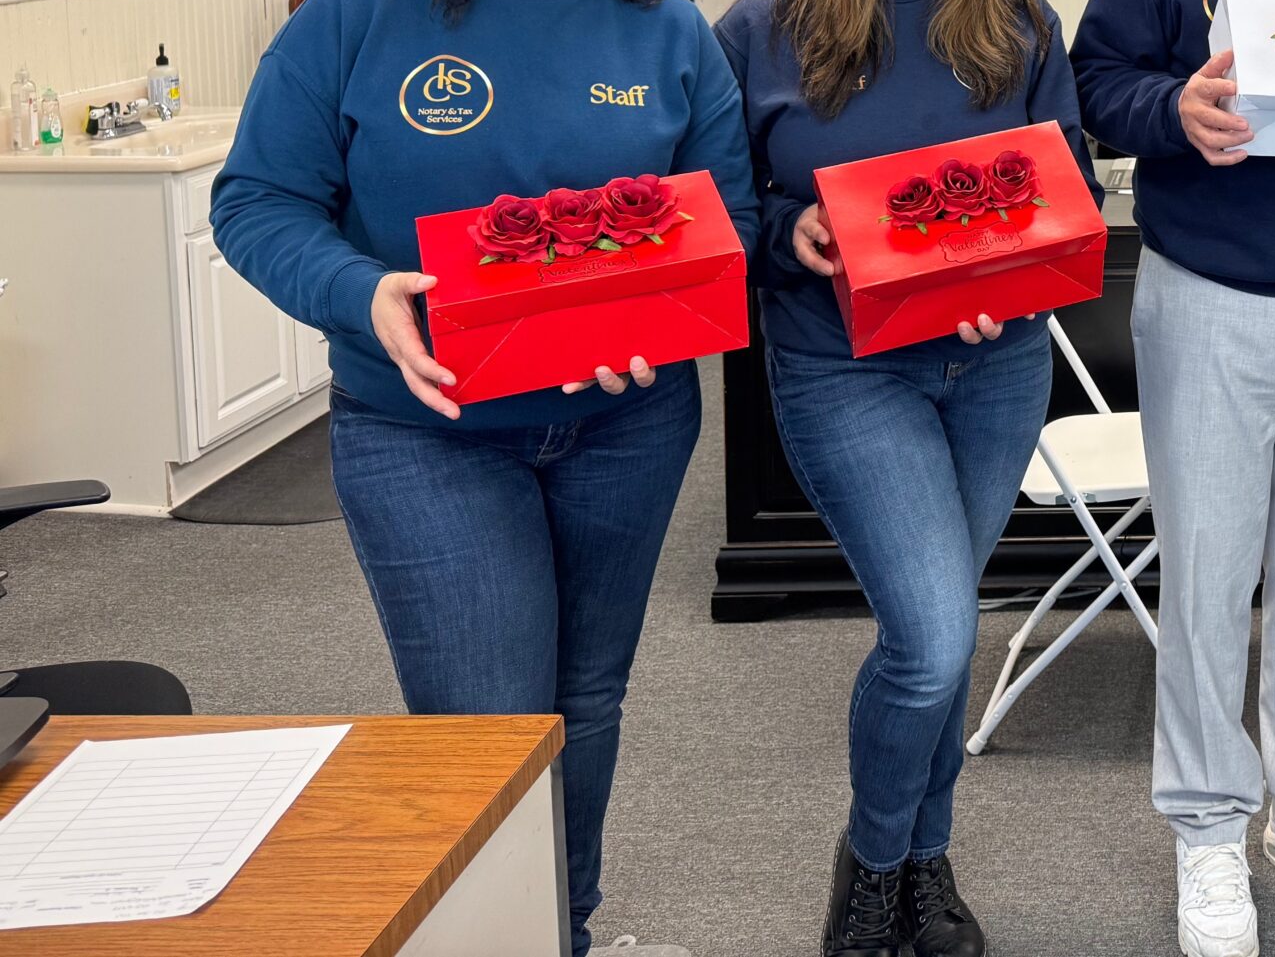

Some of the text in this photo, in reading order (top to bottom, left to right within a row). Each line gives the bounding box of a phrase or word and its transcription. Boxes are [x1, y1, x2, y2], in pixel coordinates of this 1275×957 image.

[590, 83, 649, 107] Staff
[418, 107, 473, 116] Notary & Tax
[426, 115, 463, 123] Services
[943, 233, 1015, 252] Valentines
